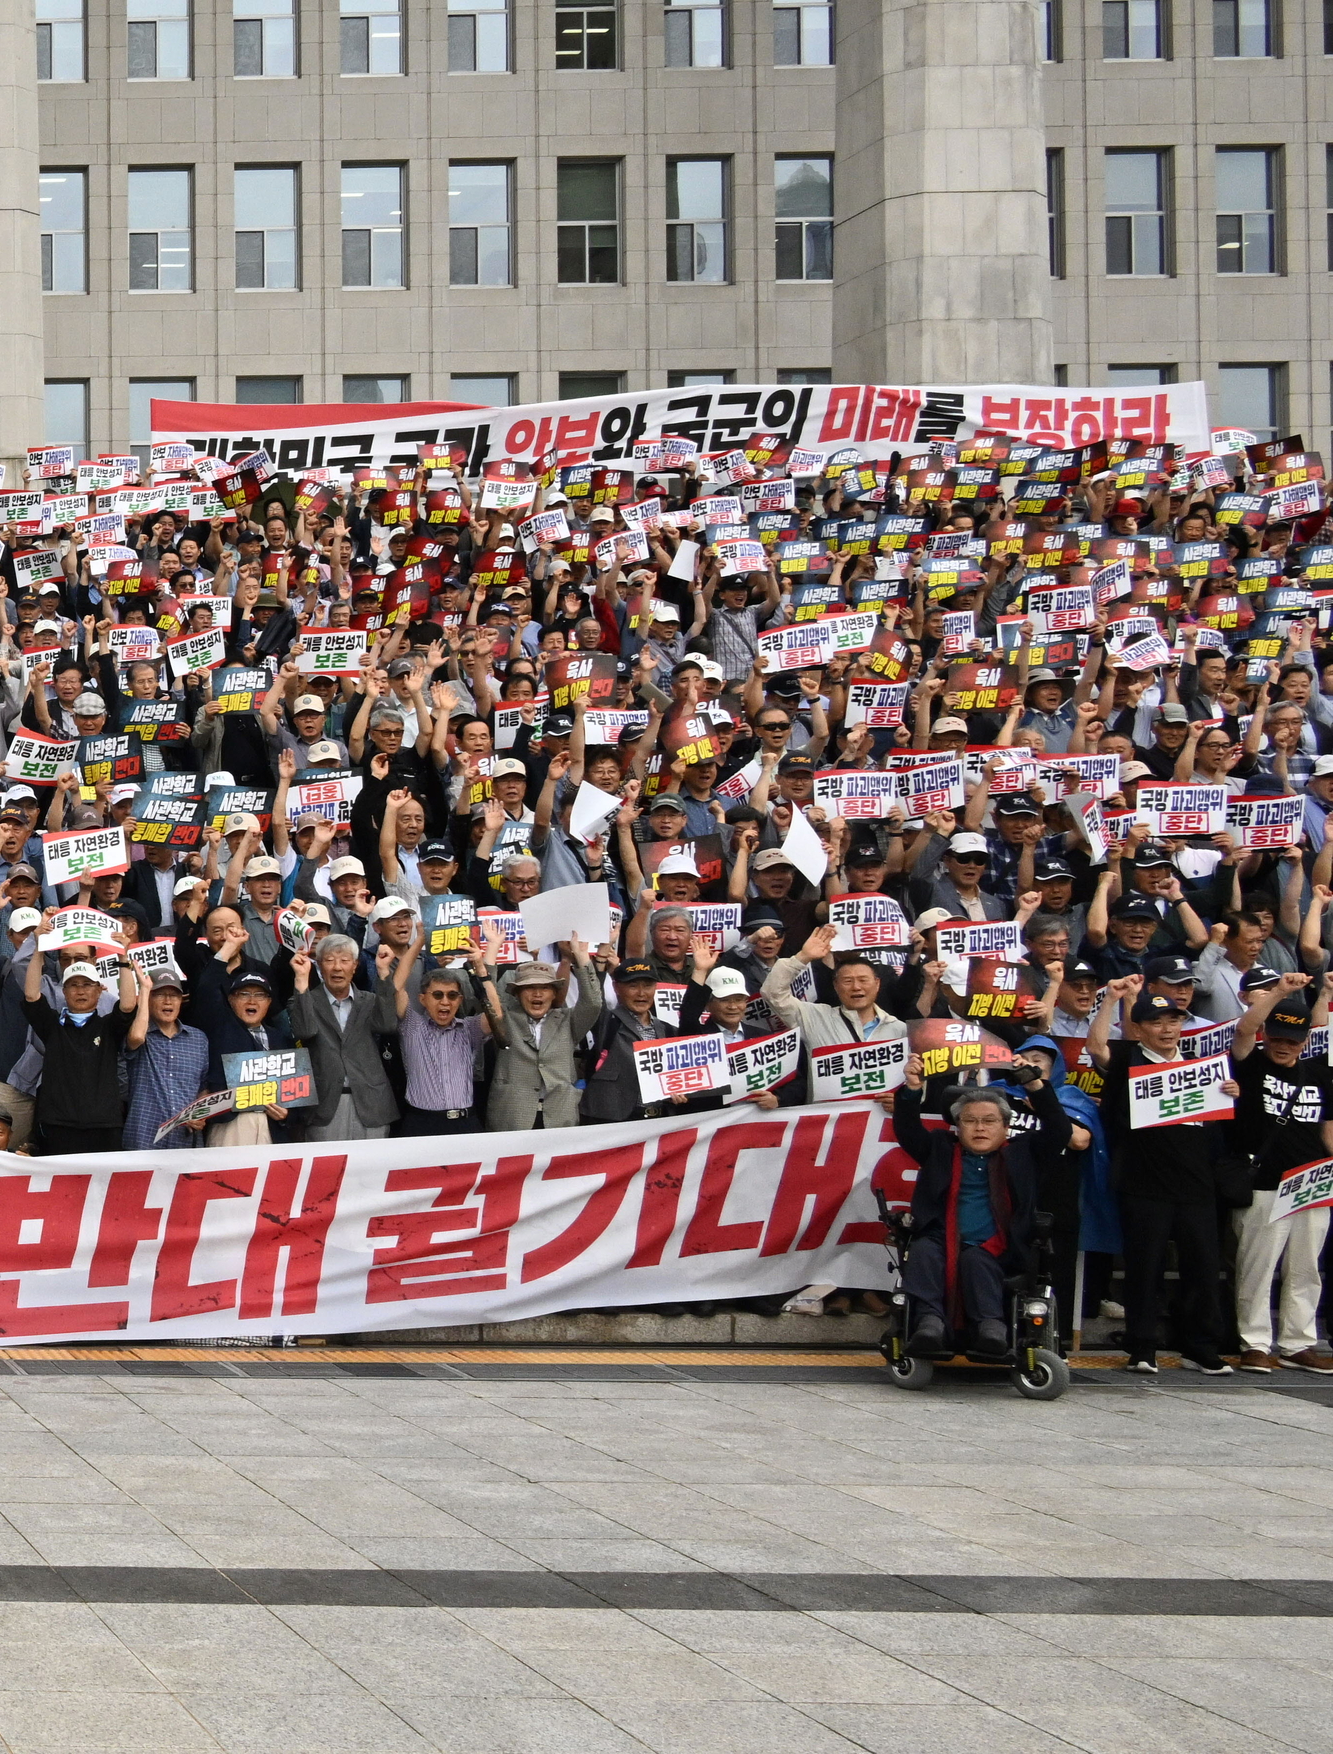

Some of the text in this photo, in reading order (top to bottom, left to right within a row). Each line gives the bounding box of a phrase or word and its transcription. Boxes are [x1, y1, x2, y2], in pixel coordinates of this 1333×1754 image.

[818, 385, 966, 444] 미래를
[29, 449, 70, 465] 안보 자해행위
[41, 465, 62, 475] 중단
[1030, 589, 1090, 612] 국방 파괴행위
[1052, 611, 1082, 626] 중단
[171, 632, 221, 659] 태릉 안보성지
[304, 634, 363, 652] 태릉 안보성지
[761, 626, 830, 651] 국방 파괴행위
[187, 651, 211, 668] 보존
[315, 652, 347, 668] 보존
[785, 649, 817, 663] 중단
[13, 740, 76, 762] 태릉 자연환경
[20, 760, 57, 777] 보전
[1139, 788, 1224, 811] 국방 파괴행위
[145, 801, 198, 822] 사관학교
[132, 821, 201, 845] 통폐합 반대
[1165, 814, 1203, 831] 중단
[72, 912, 118, 931] 안보성지
[63, 925, 101, 941] 보존
[1275, 1013, 1305, 1023] KMA
[945, 1023, 980, 1042] 육사
[639, 1038, 721, 1074] 국방 파괴행위
[816, 1043, 903, 1077] 태릉 자연환경
[923, 1044, 981, 1075] 지방 이전
[240, 1054, 296, 1082] 사관학교
[665, 1070, 703, 1089] 중단
[841, 1070, 885, 1094] 보전
[1135, 1061, 1225, 1099] 태릉 안보성지
[236, 1075, 310, 1108] 통폐합 반대
[1159, 1090, 1204, 1118] 보존
